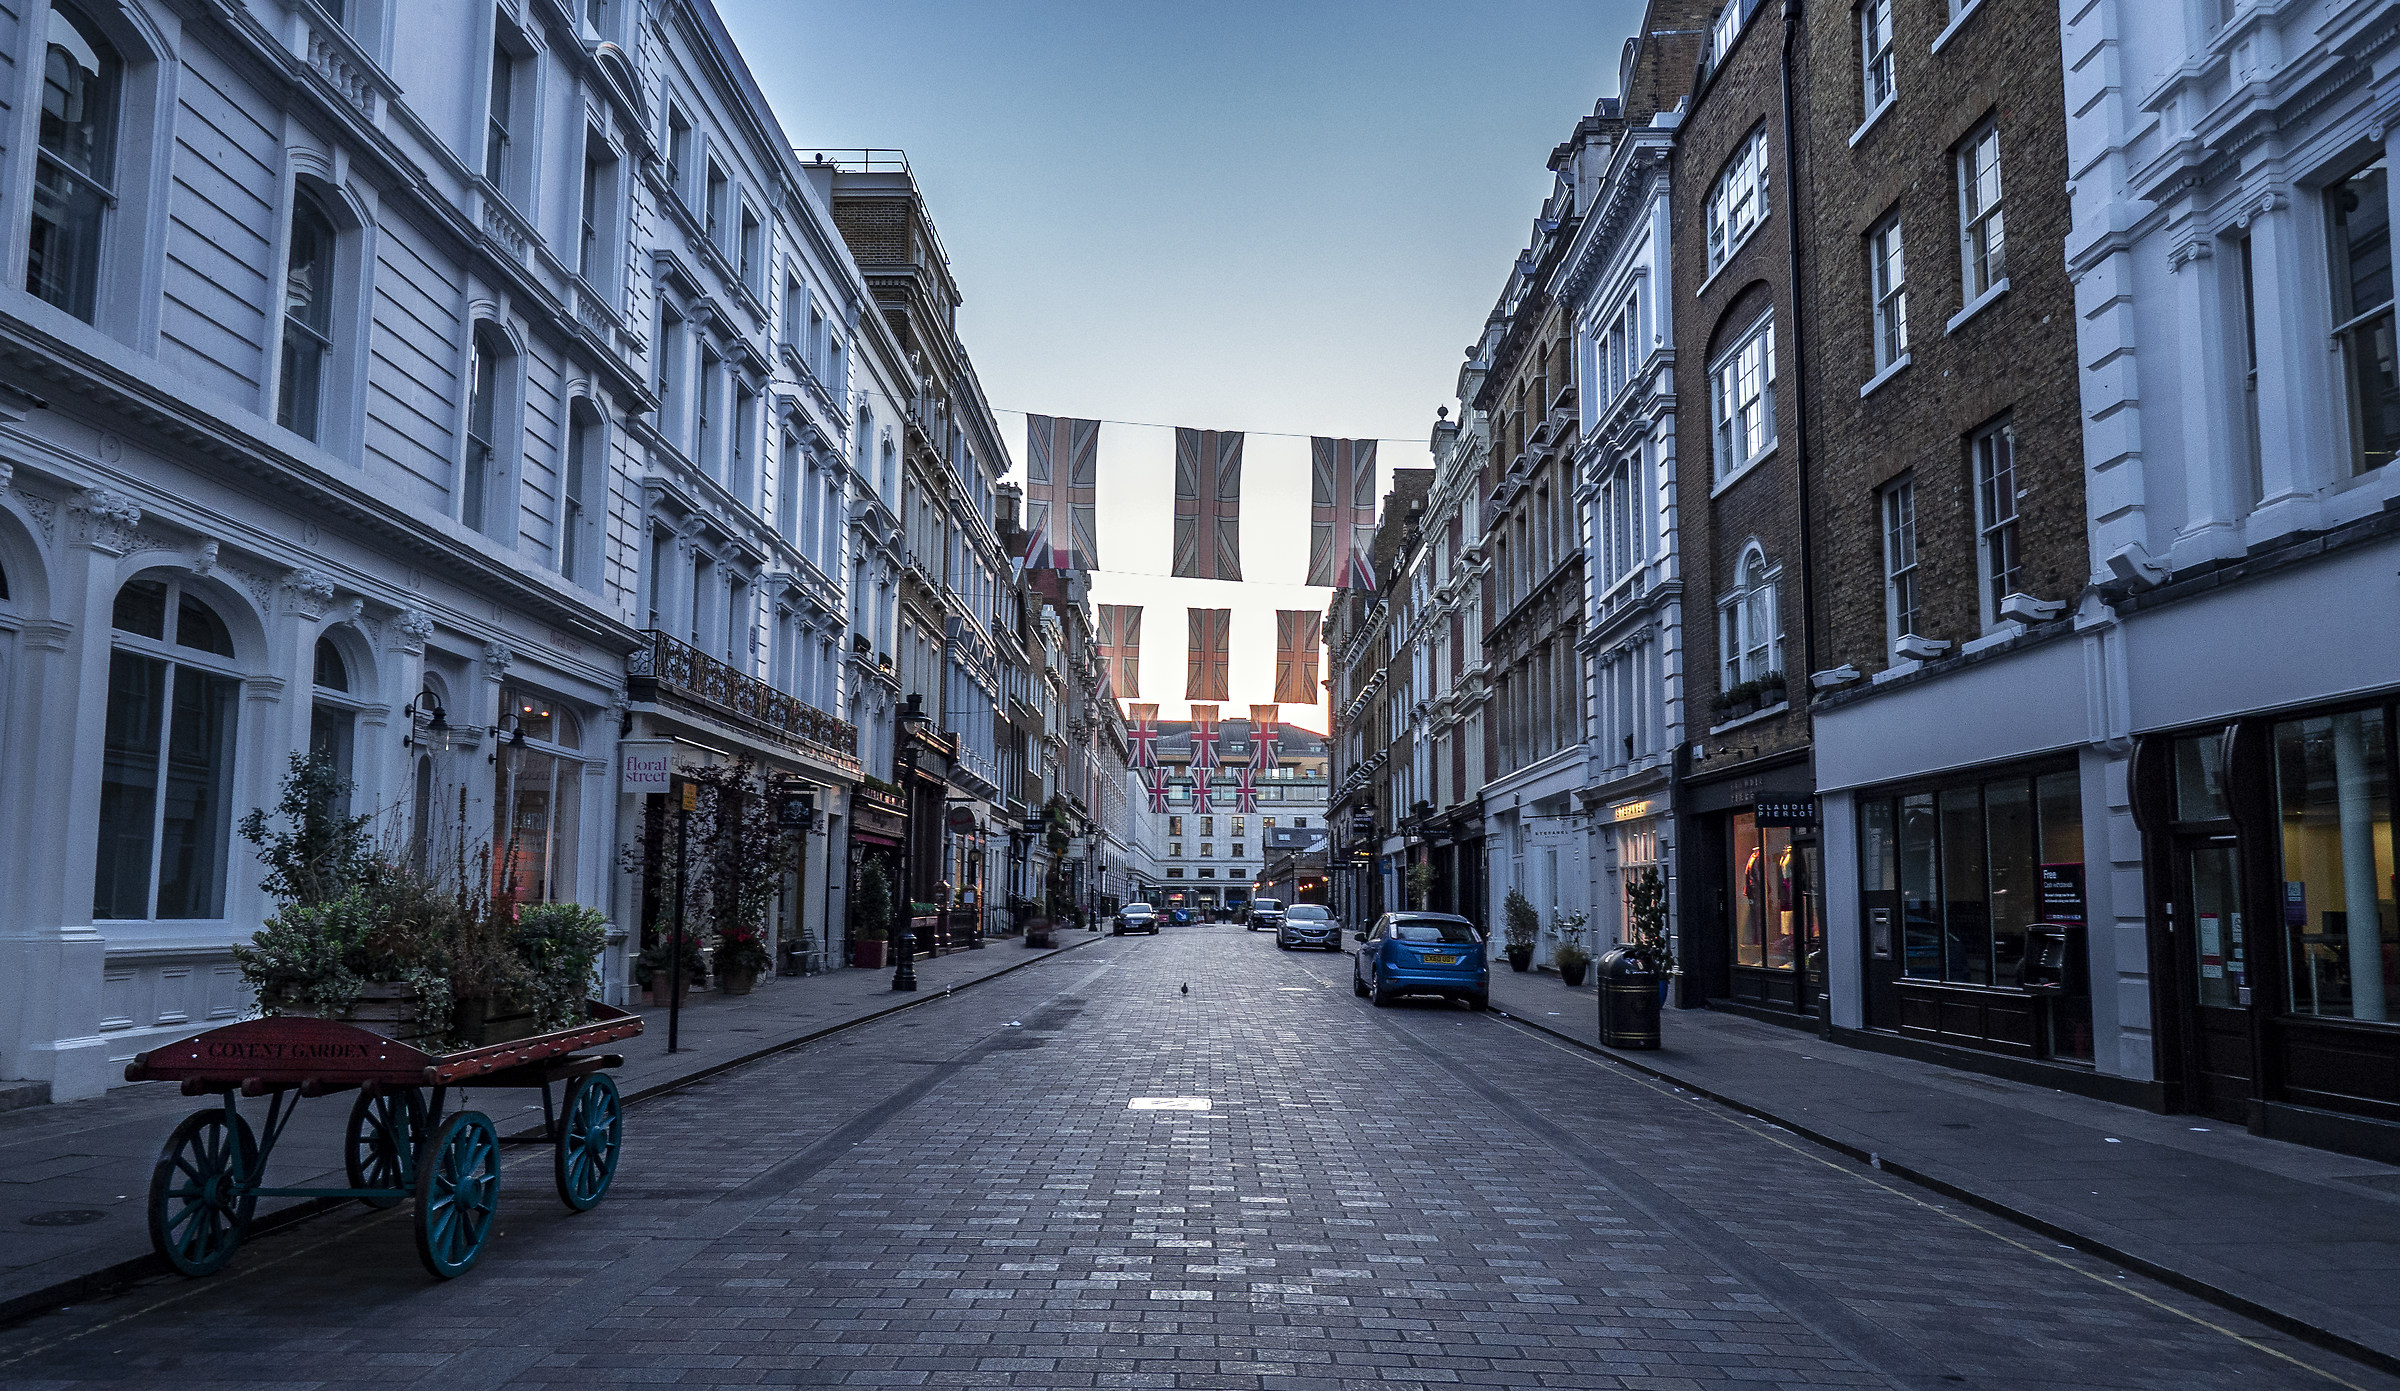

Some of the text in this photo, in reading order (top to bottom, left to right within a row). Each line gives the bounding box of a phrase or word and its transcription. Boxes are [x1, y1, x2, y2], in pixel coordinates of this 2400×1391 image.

[626, 756, 667, 771] floral
[625, 771, 667, 783] street
[1616, 803, 1645, 818] STEFANEL
[2043, 870, 2057, 879] Free
[208, 1043, 370, 1058] COVENT GARDEN
